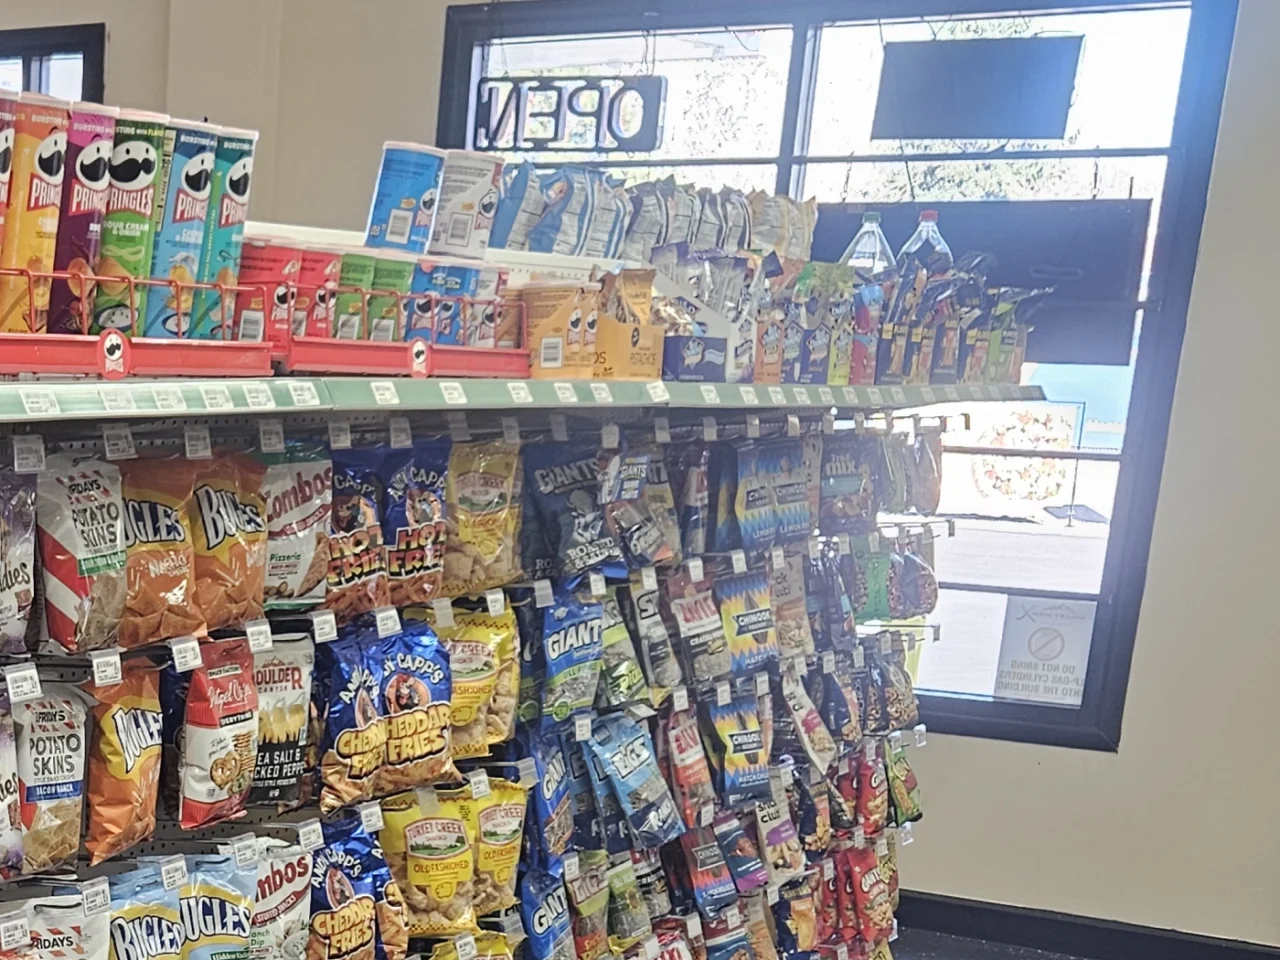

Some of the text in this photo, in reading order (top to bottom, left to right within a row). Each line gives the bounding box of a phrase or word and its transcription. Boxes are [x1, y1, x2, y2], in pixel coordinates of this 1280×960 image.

[534, 457, 601, 493] GIANTS
[825, 458, 856, 475] mix
[72, 502, 119, 530] POTATO
[83, 525, 117, 548] SKINS
[270, 552, 301, 562] Pizzeria
[397, 652, 444, 684] CAPP'S
[29, 734, 81, 756] POTATO
[388, 732, 447, 762] FRIES
[33, 755, 75, 777] SKINS
[273, 751, 294, 764] SALT
[611, 736, 650, 778] BIGS
[36, 784, 74, 795] BACON RANCH
[436, 821, 462, 834] CREEK
[413, 860, 469, 874] OLD FASHIONED
[313, 897, 376, 936] CHEDDAR
[330, 925, 373, 959] FRIES
